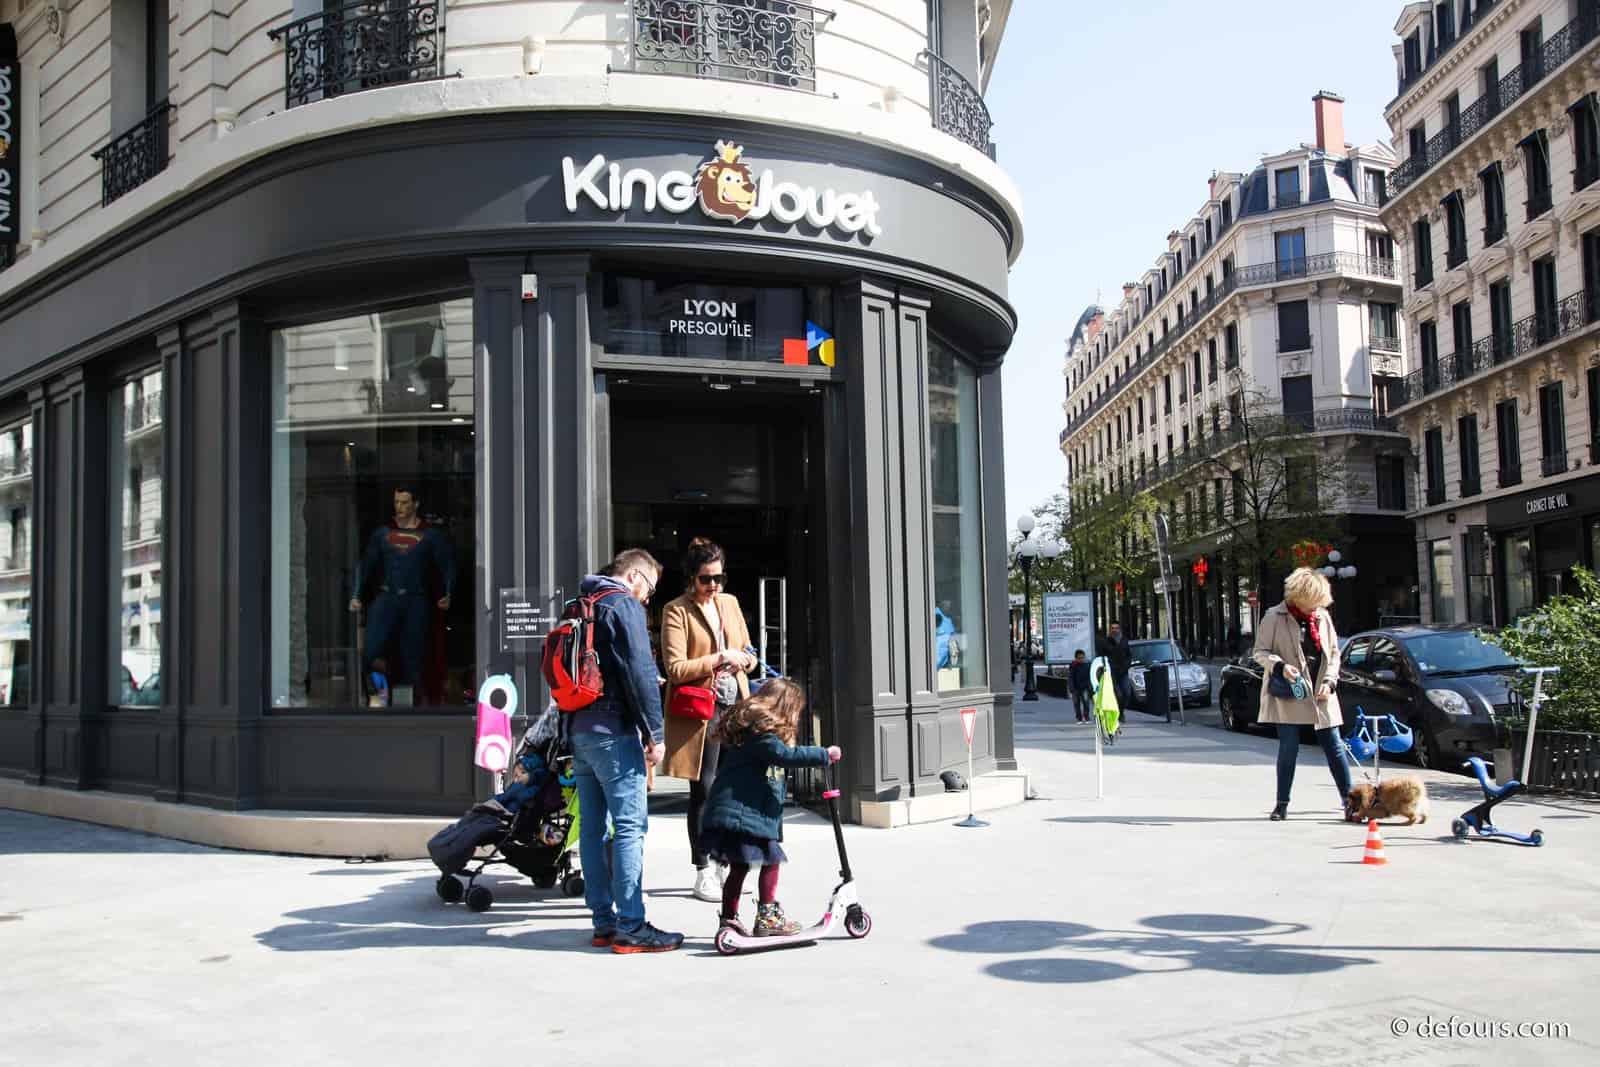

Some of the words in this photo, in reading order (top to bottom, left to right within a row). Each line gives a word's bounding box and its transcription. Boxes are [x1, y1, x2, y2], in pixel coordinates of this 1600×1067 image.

[750, 169, 882, 239] Jouet
[684, 299, 736, 317] LYON
[669, 319, 752, 337] PRESQU'ÎLE
[1526, 497, 1547, 514] CARNET
[1548, 495, 1557, 510] DE
[1556, 492, 1569, 507] VOL
